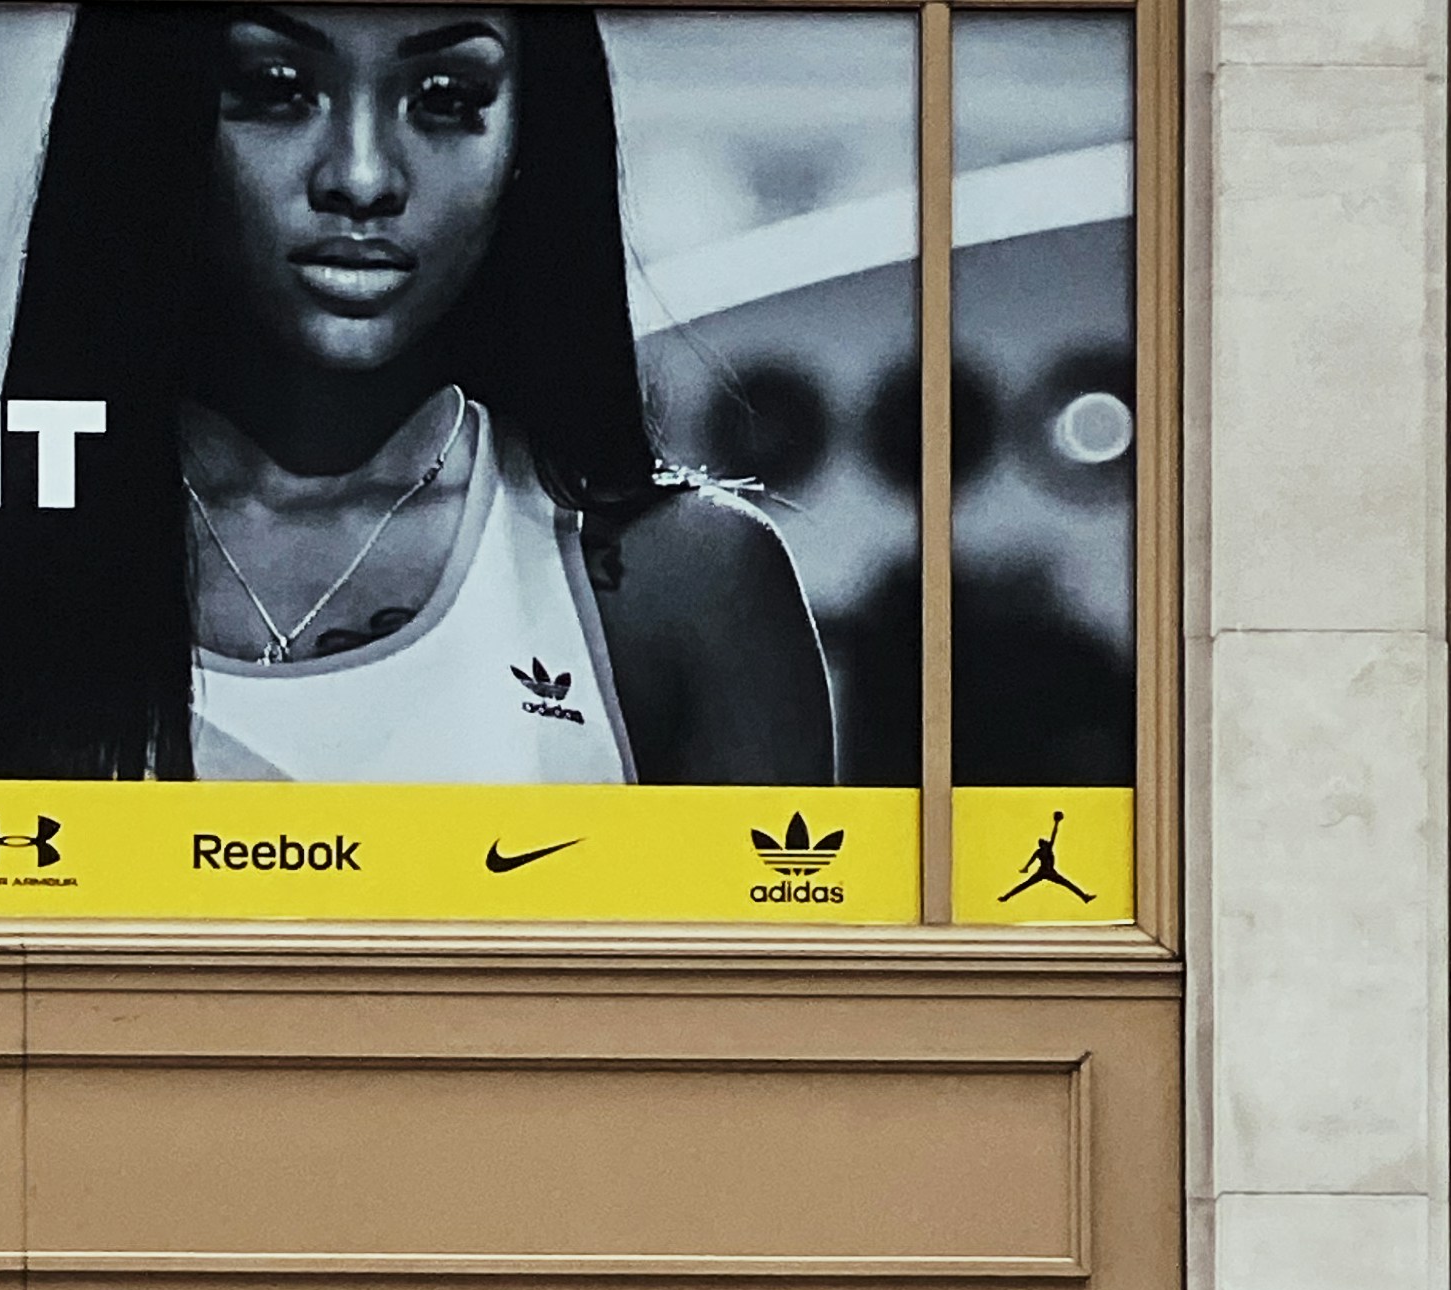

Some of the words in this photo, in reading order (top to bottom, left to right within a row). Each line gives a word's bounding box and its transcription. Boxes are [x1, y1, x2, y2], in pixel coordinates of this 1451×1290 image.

[193, 834, 361, 872] Reebok
[12, 877, 78, 888] ARMOUR
[750, 880, 844, 903] adidas
